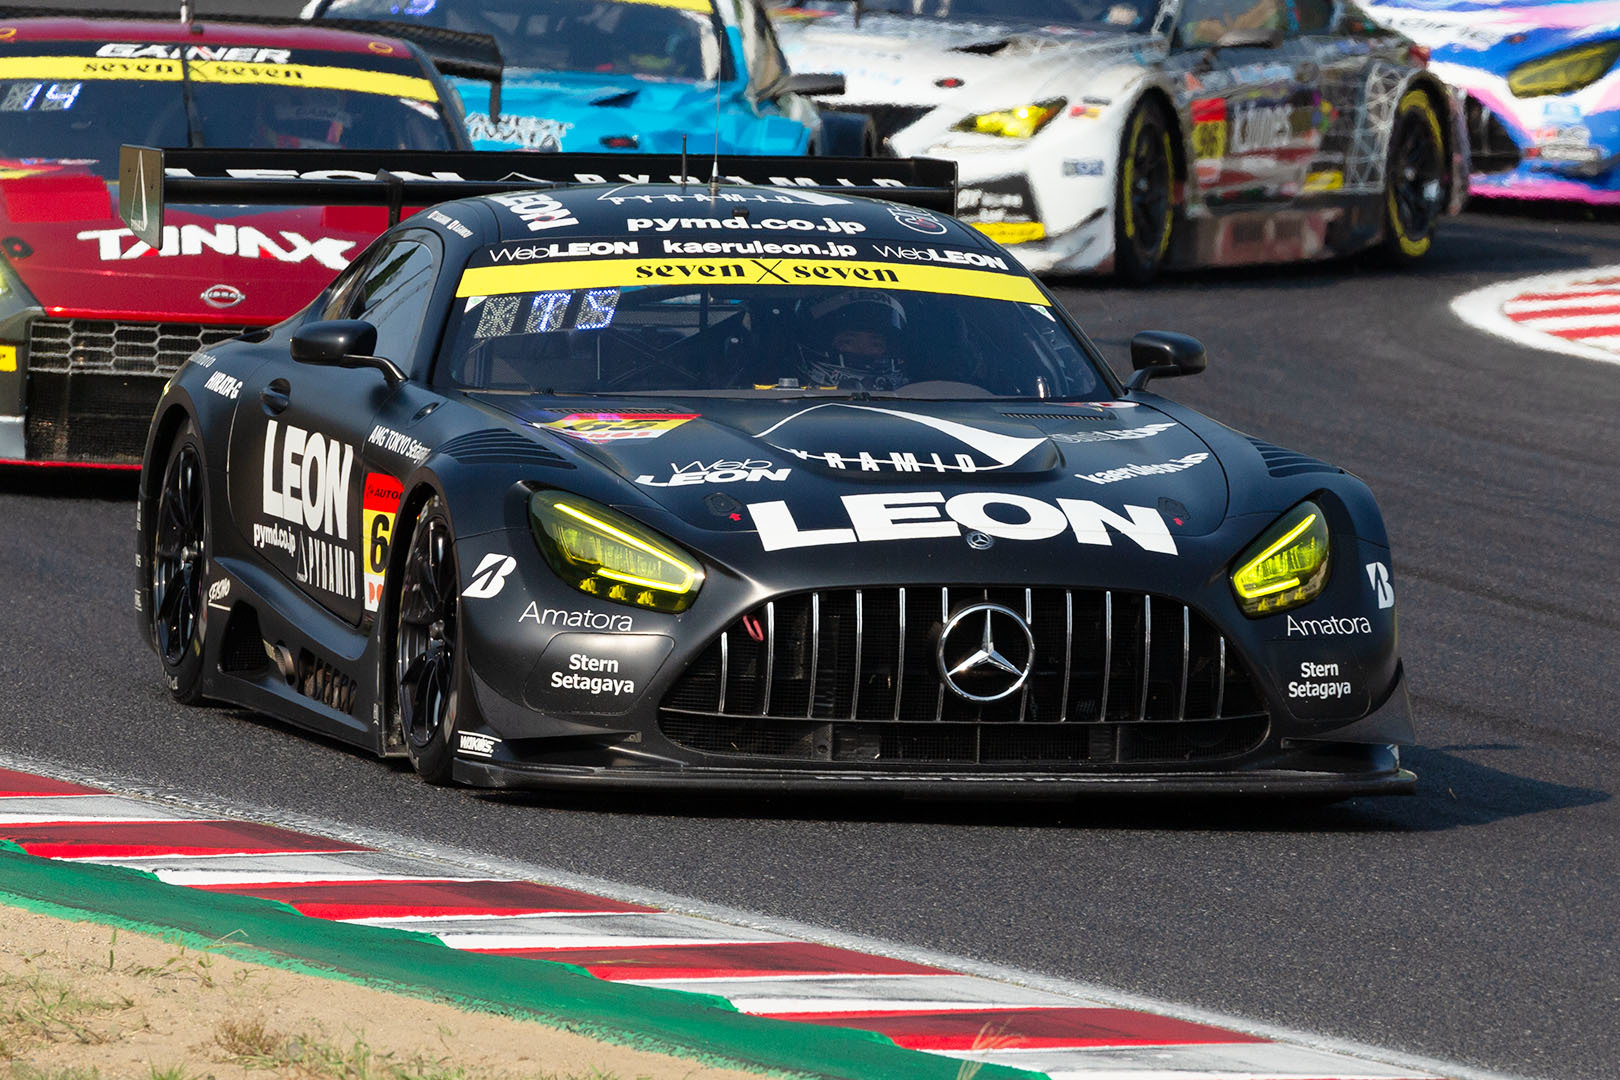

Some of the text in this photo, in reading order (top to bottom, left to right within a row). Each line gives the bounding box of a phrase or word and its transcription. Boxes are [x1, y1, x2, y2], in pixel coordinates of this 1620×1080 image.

[96, 43, 291, 64] GAINER
[83, 62, 174, 74] seven
[215, 65, 304, 80] seven
[627, 216, 867, 234] pymd.co.jp
[489, 241, 639, 262] WebLEON
[663, 239, 858, 258] kaeruleon.jp
[872, 244, 1009, 270] WebLEON
[636, 264, 745, 279] seven
[794, 265, 899, 283] seven
[368, 425, 390, 447] AMG
[384, 430, 412, 455] TOKYO
[671, 458, 774, 474] Web
[263, 419, 354, 540] LEON
[635, 468, 792, 487] LEON
[746, 491, 1179, 556] LEON
[253, 522, 296, 558] pymd.co.jp
[308, 535, 356, 600] PYRAMID
[518, 600, 634, 632] Amatora
[1286, 614, 1373, 637] Amatora
[568, 653, 620, 674] Stern
[1300, 662, 1340, 678] Stern
[550, 671, 636, 696] Setagaya
[1287, 681, 1352, 700] Setagaya
